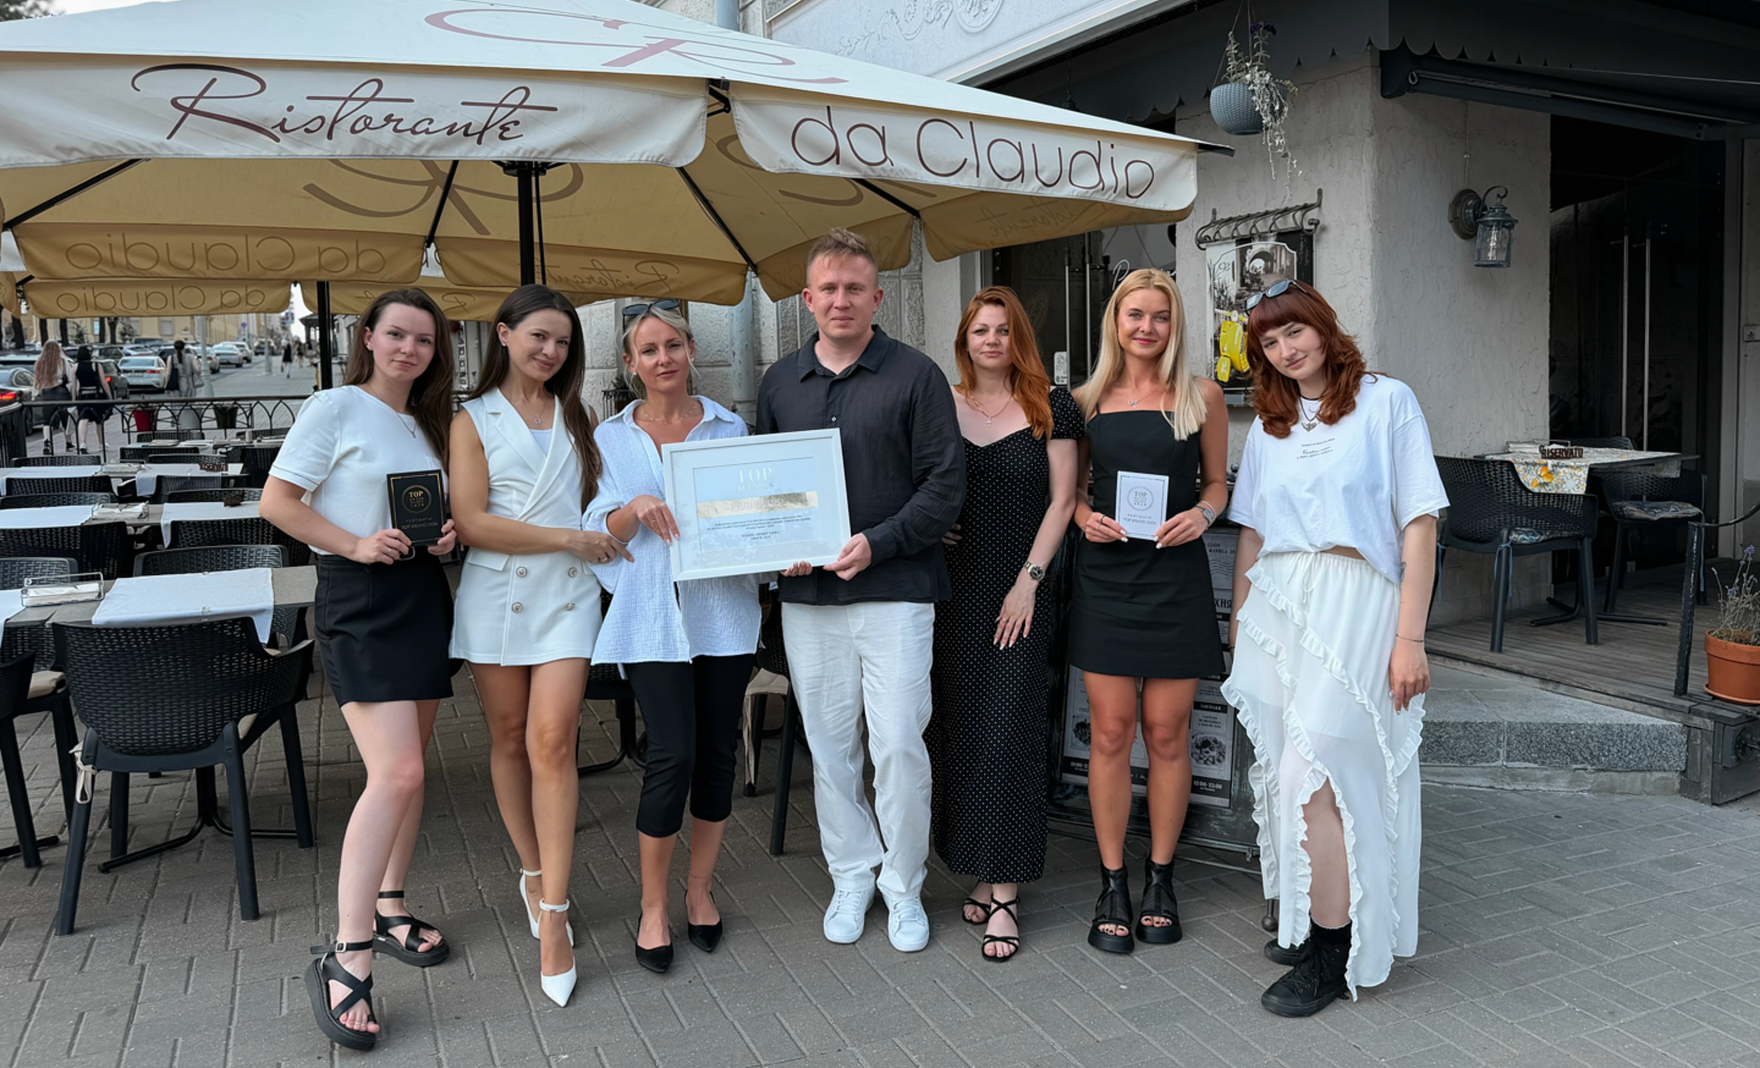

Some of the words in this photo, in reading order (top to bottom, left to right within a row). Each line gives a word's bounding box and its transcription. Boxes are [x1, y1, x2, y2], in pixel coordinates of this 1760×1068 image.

[131, 63, 559, 146] Ristorante
[791, 105, 894, 167] da
[916, 118, 1155, 199] Claudio
[408, 490, 424, 498] TOP
[735, 467, 773, 483] TOP
